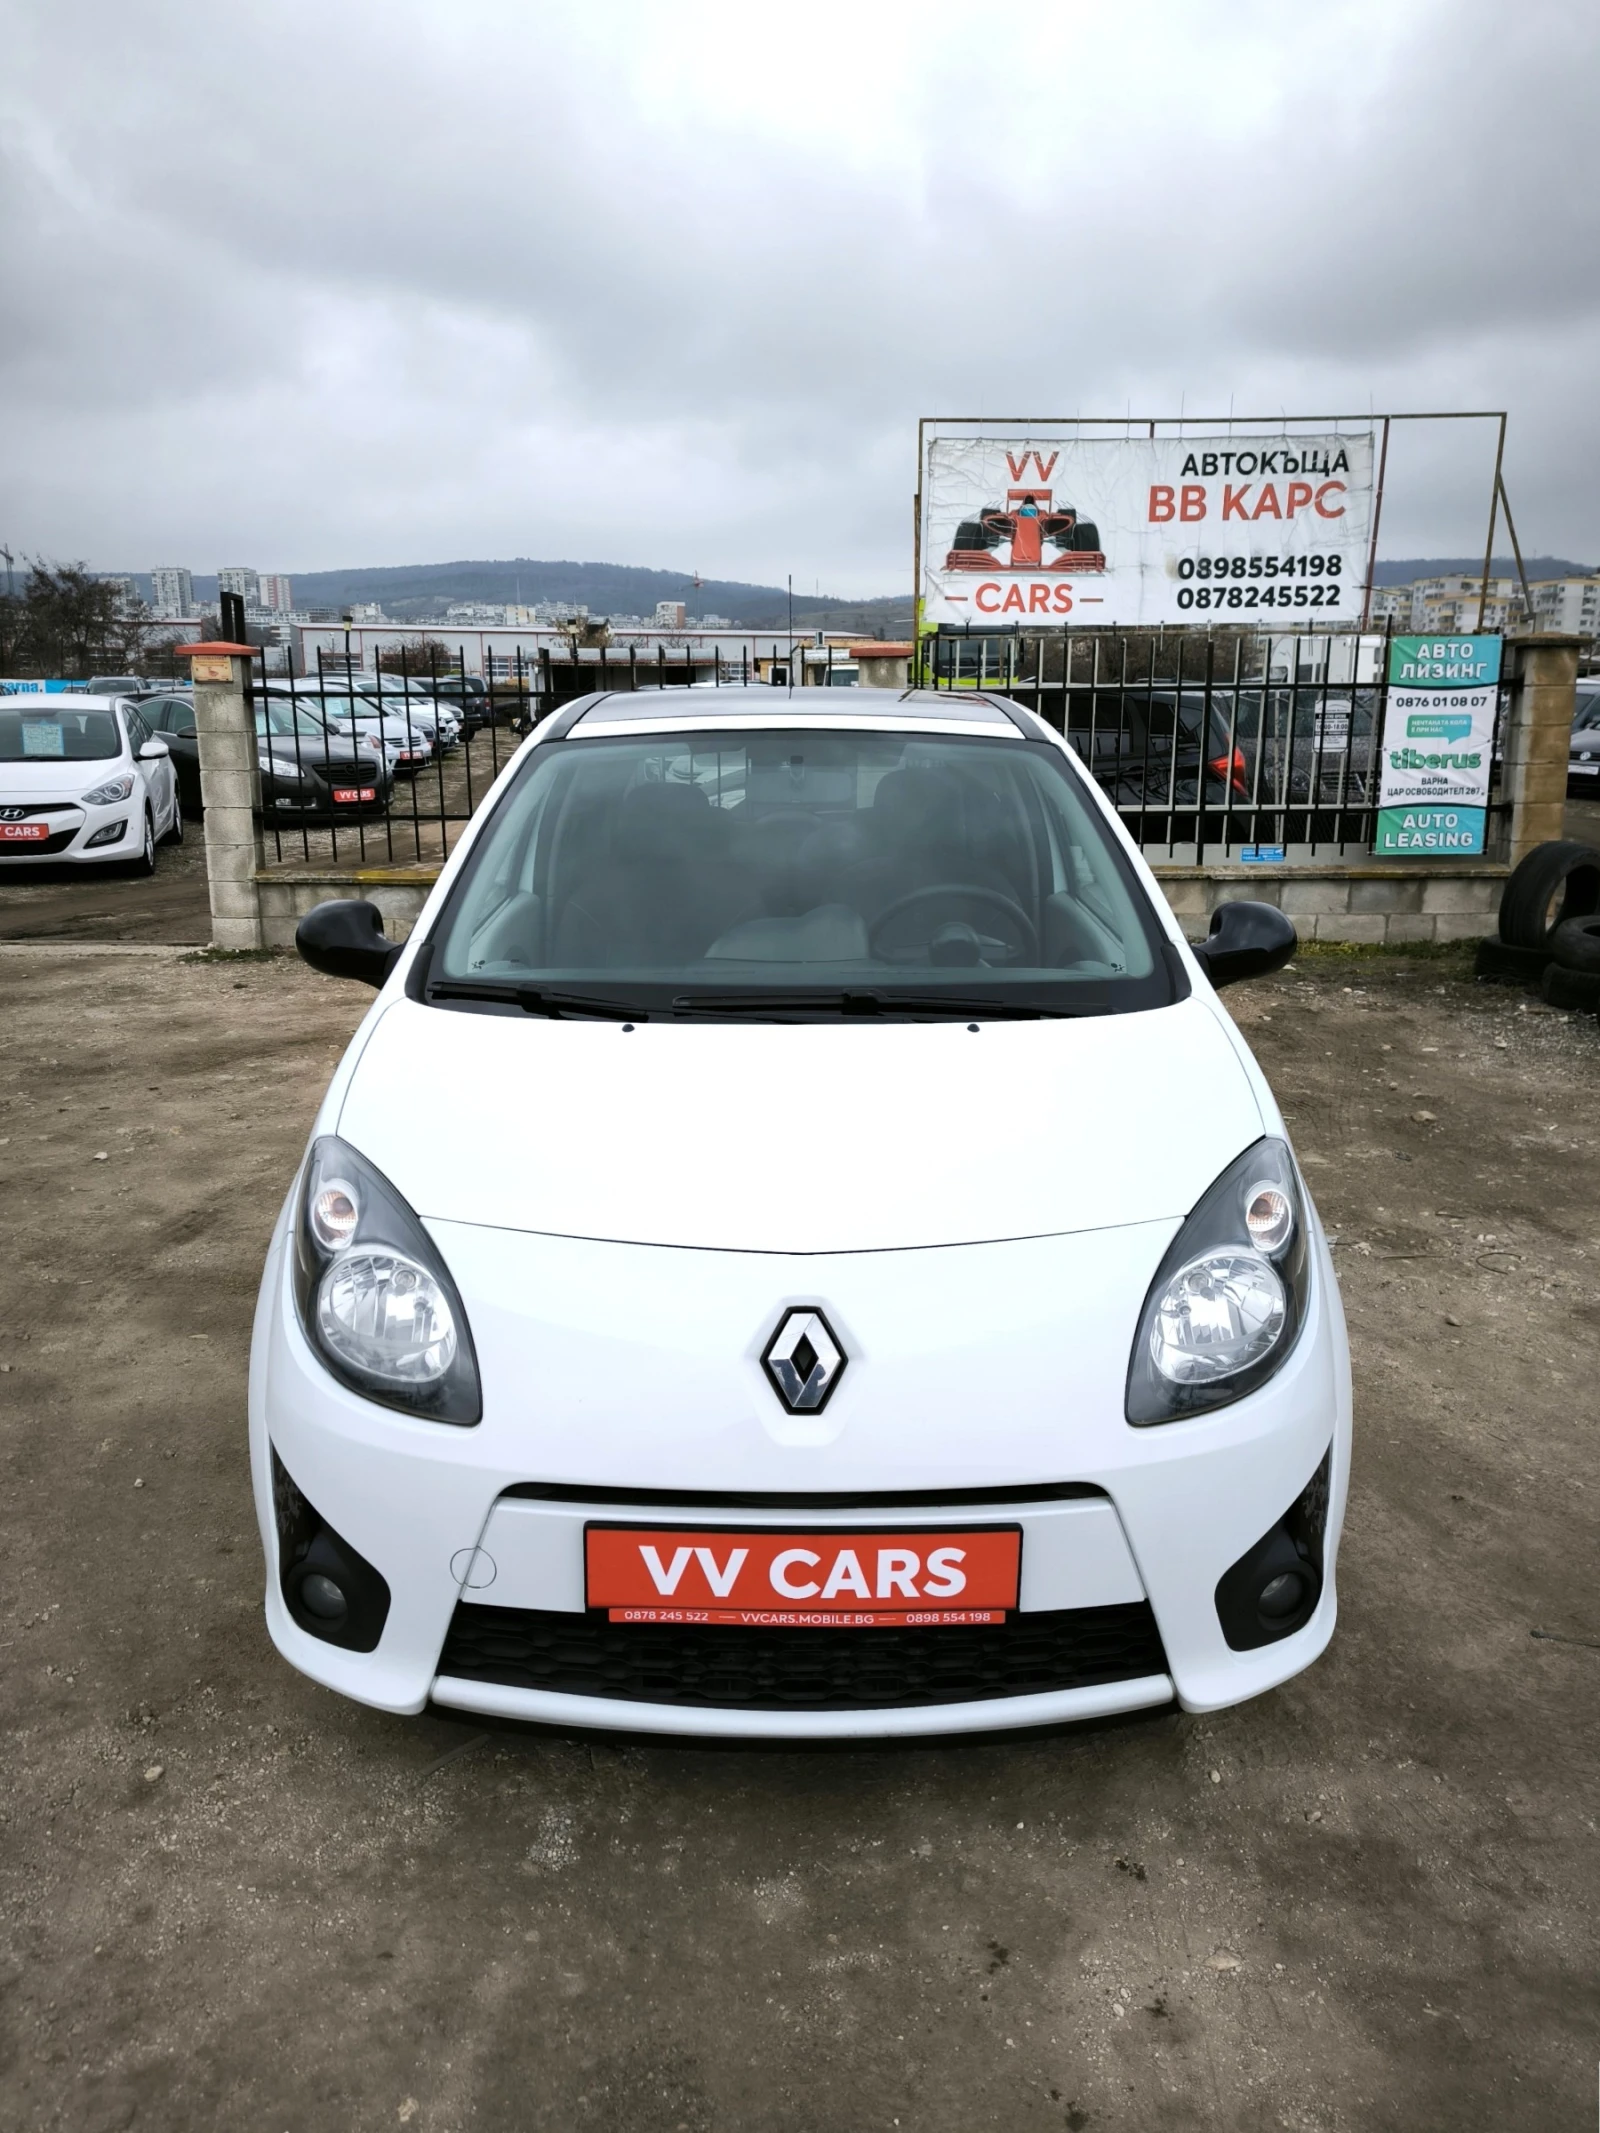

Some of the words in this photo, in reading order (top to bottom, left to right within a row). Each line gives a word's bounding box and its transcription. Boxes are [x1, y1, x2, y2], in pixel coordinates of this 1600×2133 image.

[1005, 451, 1060, 482] VV
[1180, 449, 1349, 477] АВТОКЪЩА
[1148, 484, 1207, 523] ВВ
[1222, 481, 1347, 521] КАРС
[1177, 554, 1342, 581] 0898554198
[975, 582, 1073, 614] CARS
[1177, 584, 1341, 610] 0878245522
[1417, 643, 1474, 659] АВТО
[1400, 662, 1487, 679] ЛИЗИНГ
[2, 681, 38, 693] arna
[1396, 697, 1429, 707] 0876
[1432, 696, 1447, 707] 01
[1451, 696, 1467, 707] 08
[1471, 696, 1487, 707] 07
[1390, 748, 1481, 769] tiberus
[1421, 777, 1448, 785] ВАРНА
[1387, 788, 1404, 796] ЦАР
[1406, 787, 1464, 796] ОСВОБОДИТЕЛ
[1466, 787, 1480, 795] 287
[1403, 813, 1458, 828] AUTO
[4, 826, 40, 837] CARS
[1384, 832, 1473, 848] LEASING
[638, 1545, 750, 1597] VV
[769, 1547, 967, 1600] CARS
[624, 1611, 656, 1621] 0878
[659, 1611, 683, 1621] 245
[686, 1611, 709, 1621] 522
[741, 1613, 874, 1624] VVCARS.MOBILE.BG
[905, 1613, 940, 1624] 0898
[942, 1612, 966, 1623] 554
[969, 1612, 991, 1622] 198
